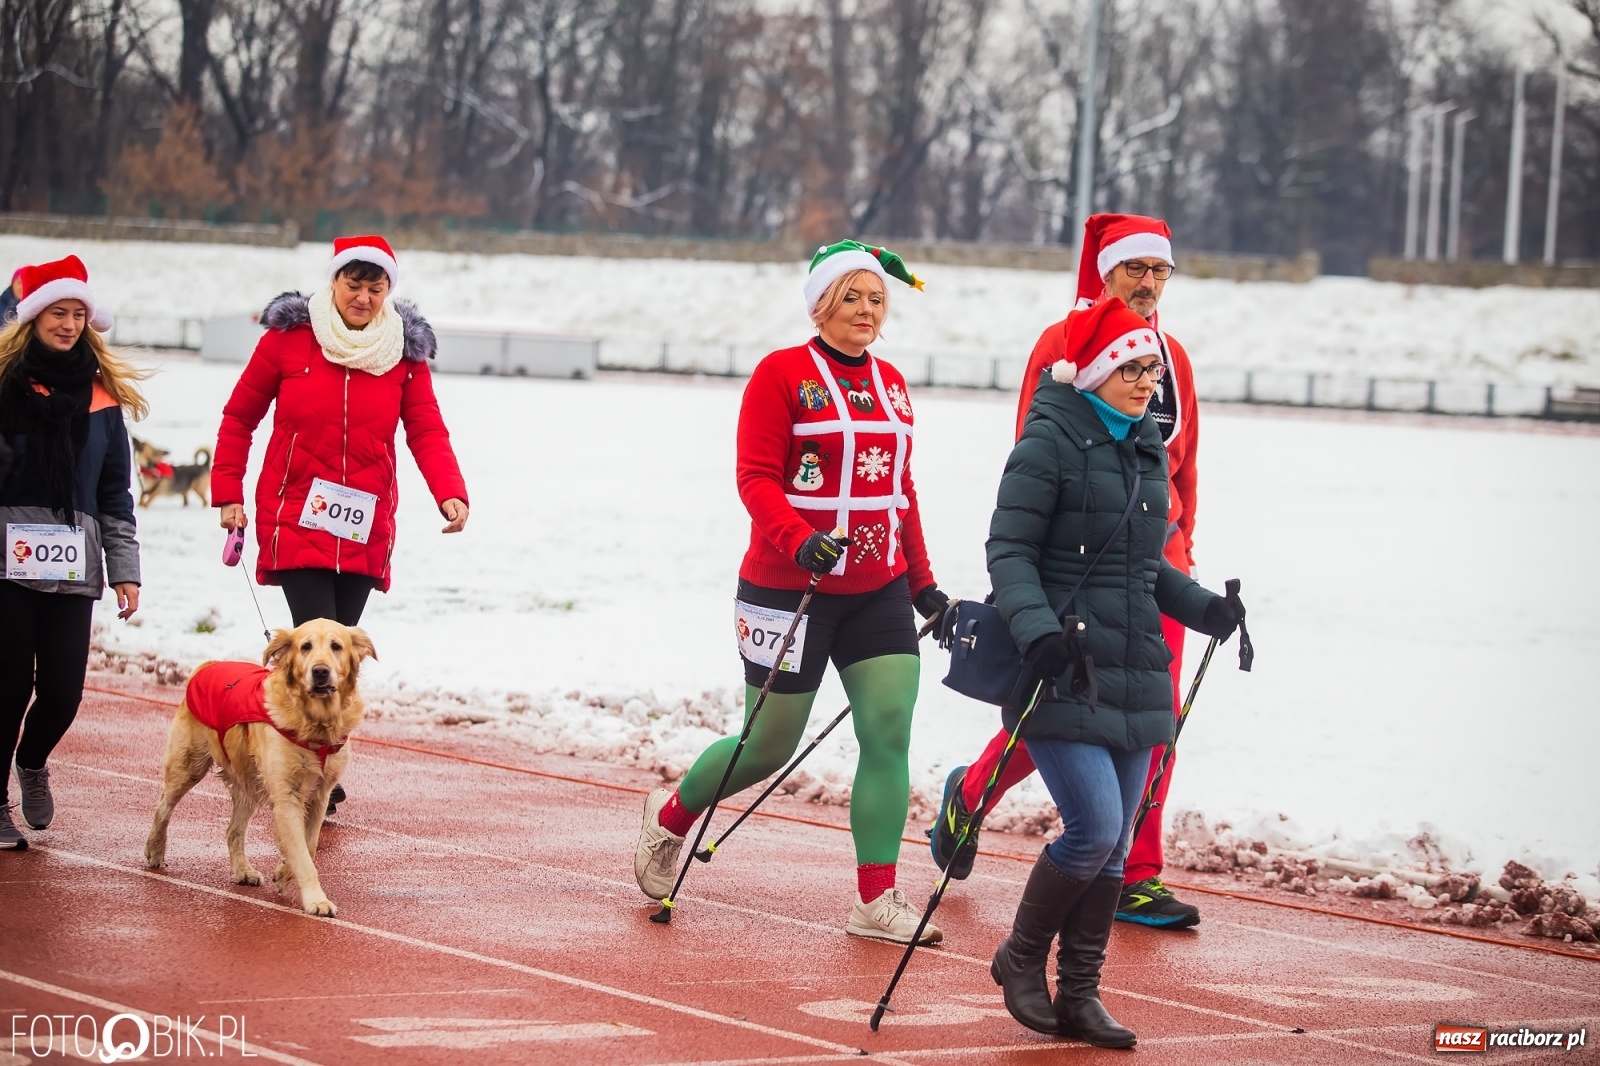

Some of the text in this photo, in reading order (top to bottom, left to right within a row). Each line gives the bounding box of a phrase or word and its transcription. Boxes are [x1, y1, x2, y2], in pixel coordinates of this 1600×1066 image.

[328, 503, 364, 525] 019
[35, 544, 78, 563] 020
[751, 627, 796, 653] 072
